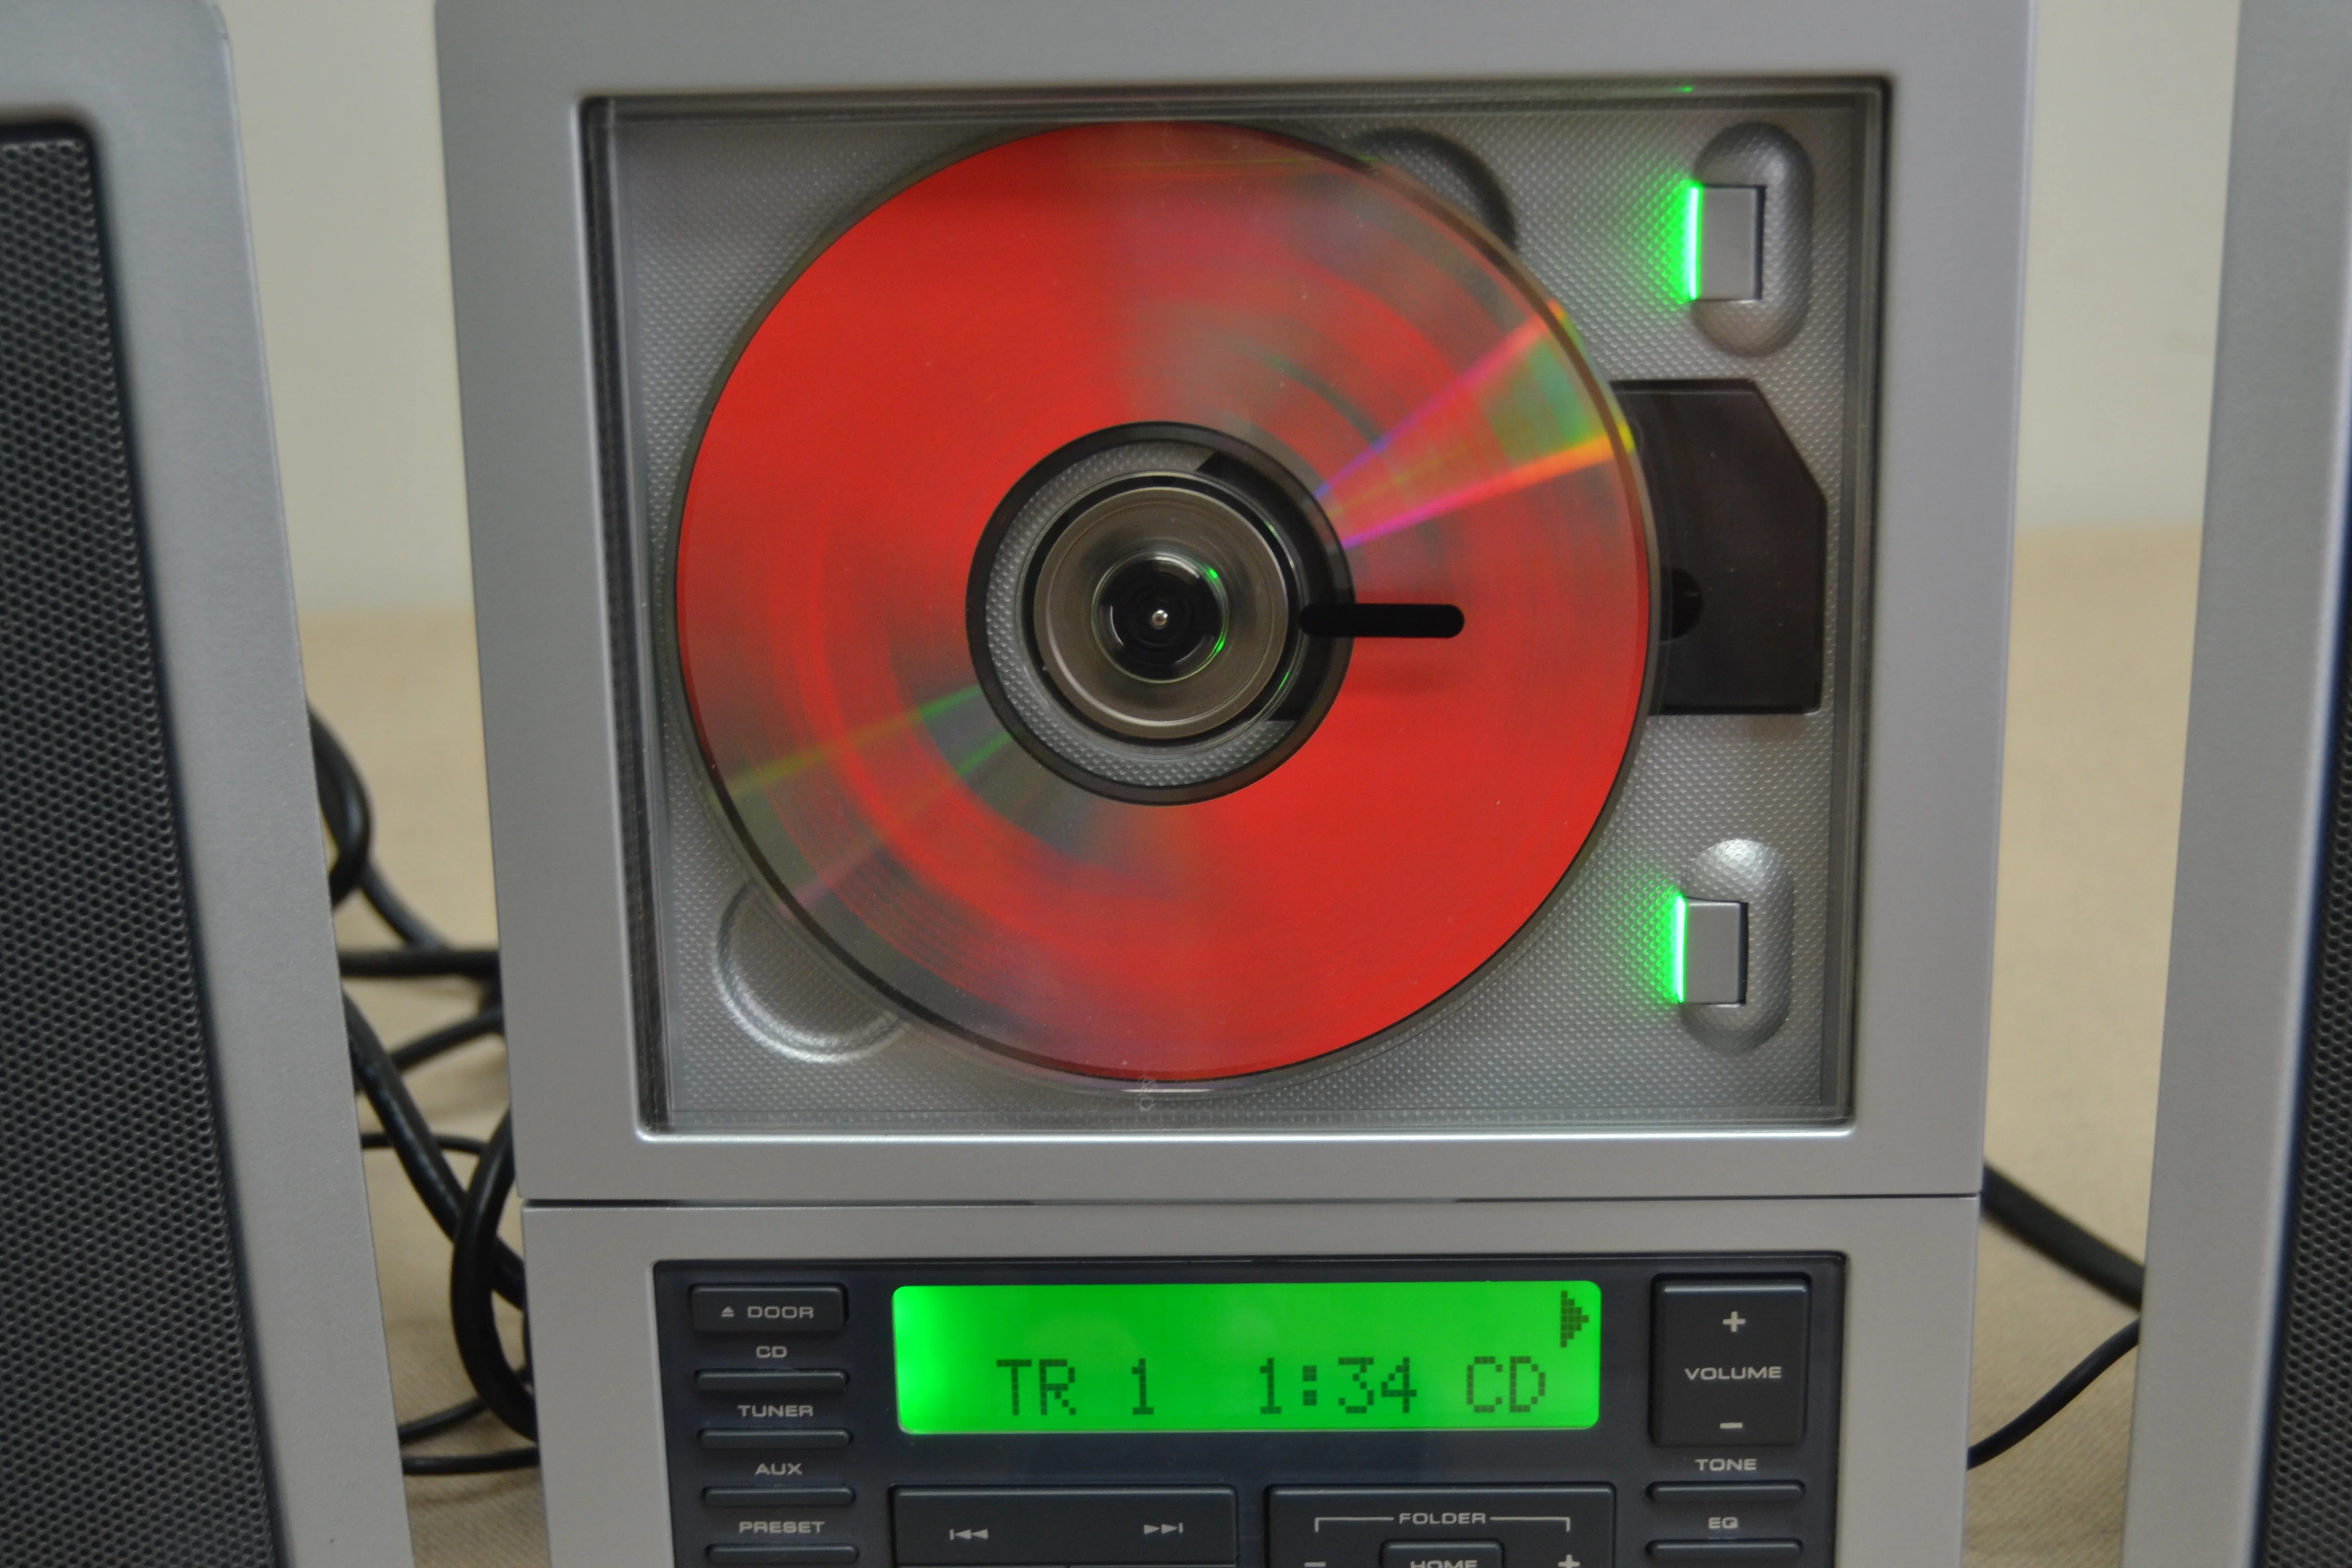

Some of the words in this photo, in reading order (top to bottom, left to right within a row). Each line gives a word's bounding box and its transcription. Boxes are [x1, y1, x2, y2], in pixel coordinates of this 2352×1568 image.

[747, 1306, 814, 1319] DOOR
[756, 1346, 787, 1359] CD
[1684, 1366, 1782, 1380] VOLUME
[996, 1358, 1077, 1416] TR
[1132, 1358, 1155, 1415] 1
[1259, 1357, 1417, 1414] 1:34
[1466, 1356, 1546, 1413] CD
[738, 1405, 814, 1417] TUNER
[755, 1463, 803, 1476] AUX
[1695, 1459, 1757, 1472] TONE
[1399, 1512, 1486, 1525] FOLDER
[1708, 1517, 1738, 1530] EQ
[739, 1521, 825, 1534] PRESET
[1410, 1560, 1478, 1568] HOME
